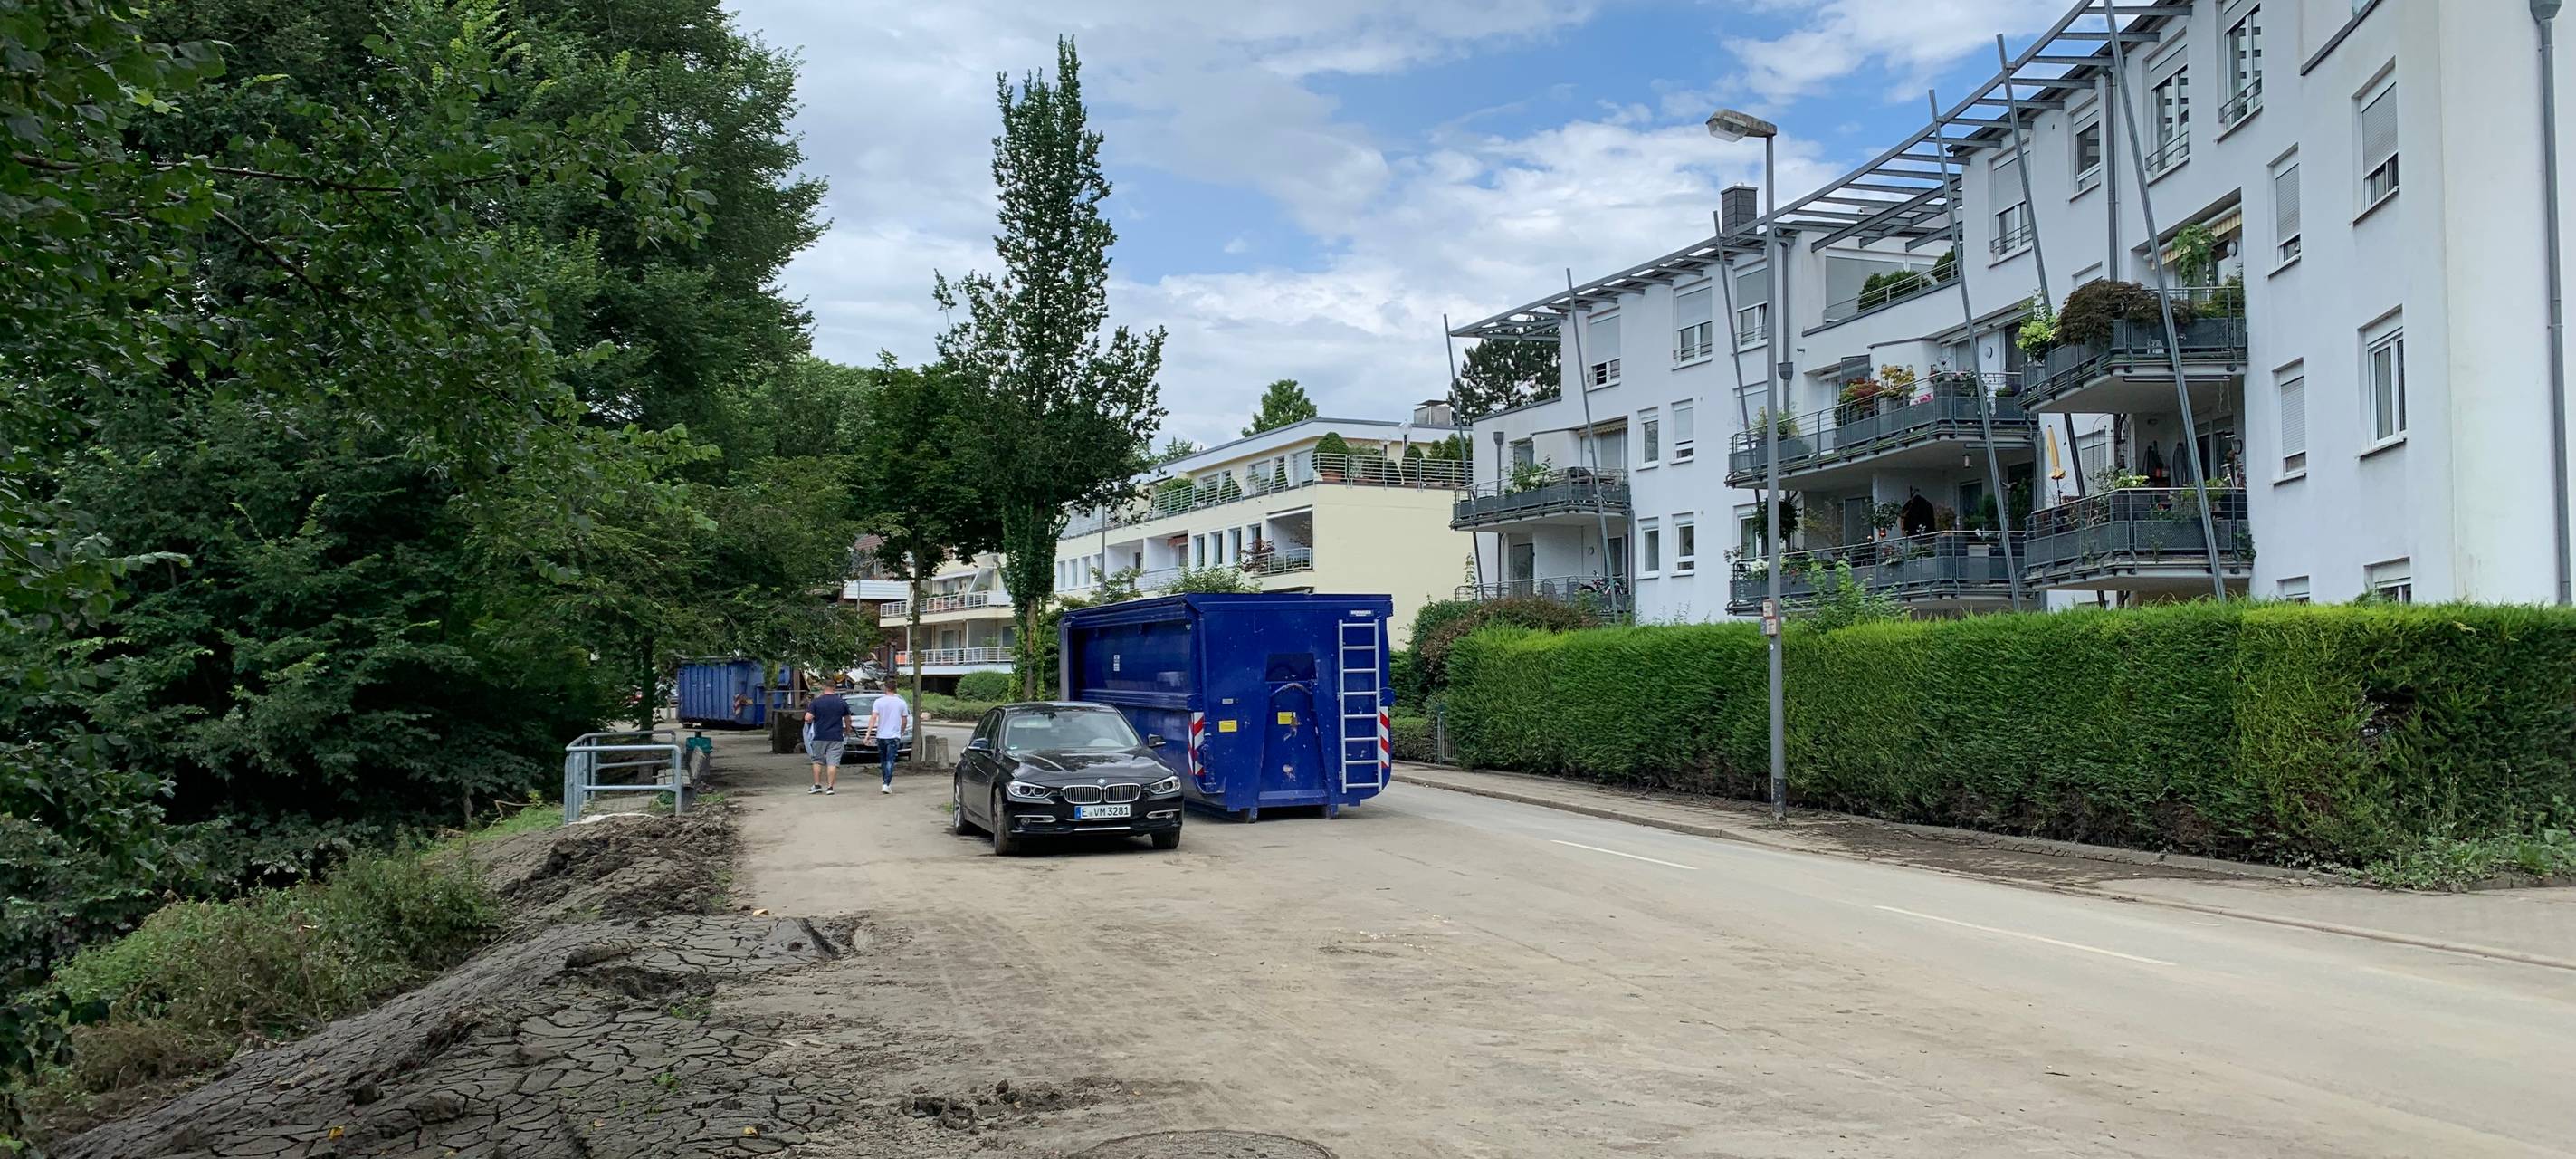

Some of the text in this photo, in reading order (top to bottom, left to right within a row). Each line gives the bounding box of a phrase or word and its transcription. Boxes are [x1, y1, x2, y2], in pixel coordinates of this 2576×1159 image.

[1082, 806, 1129, 817] E VM 3281
